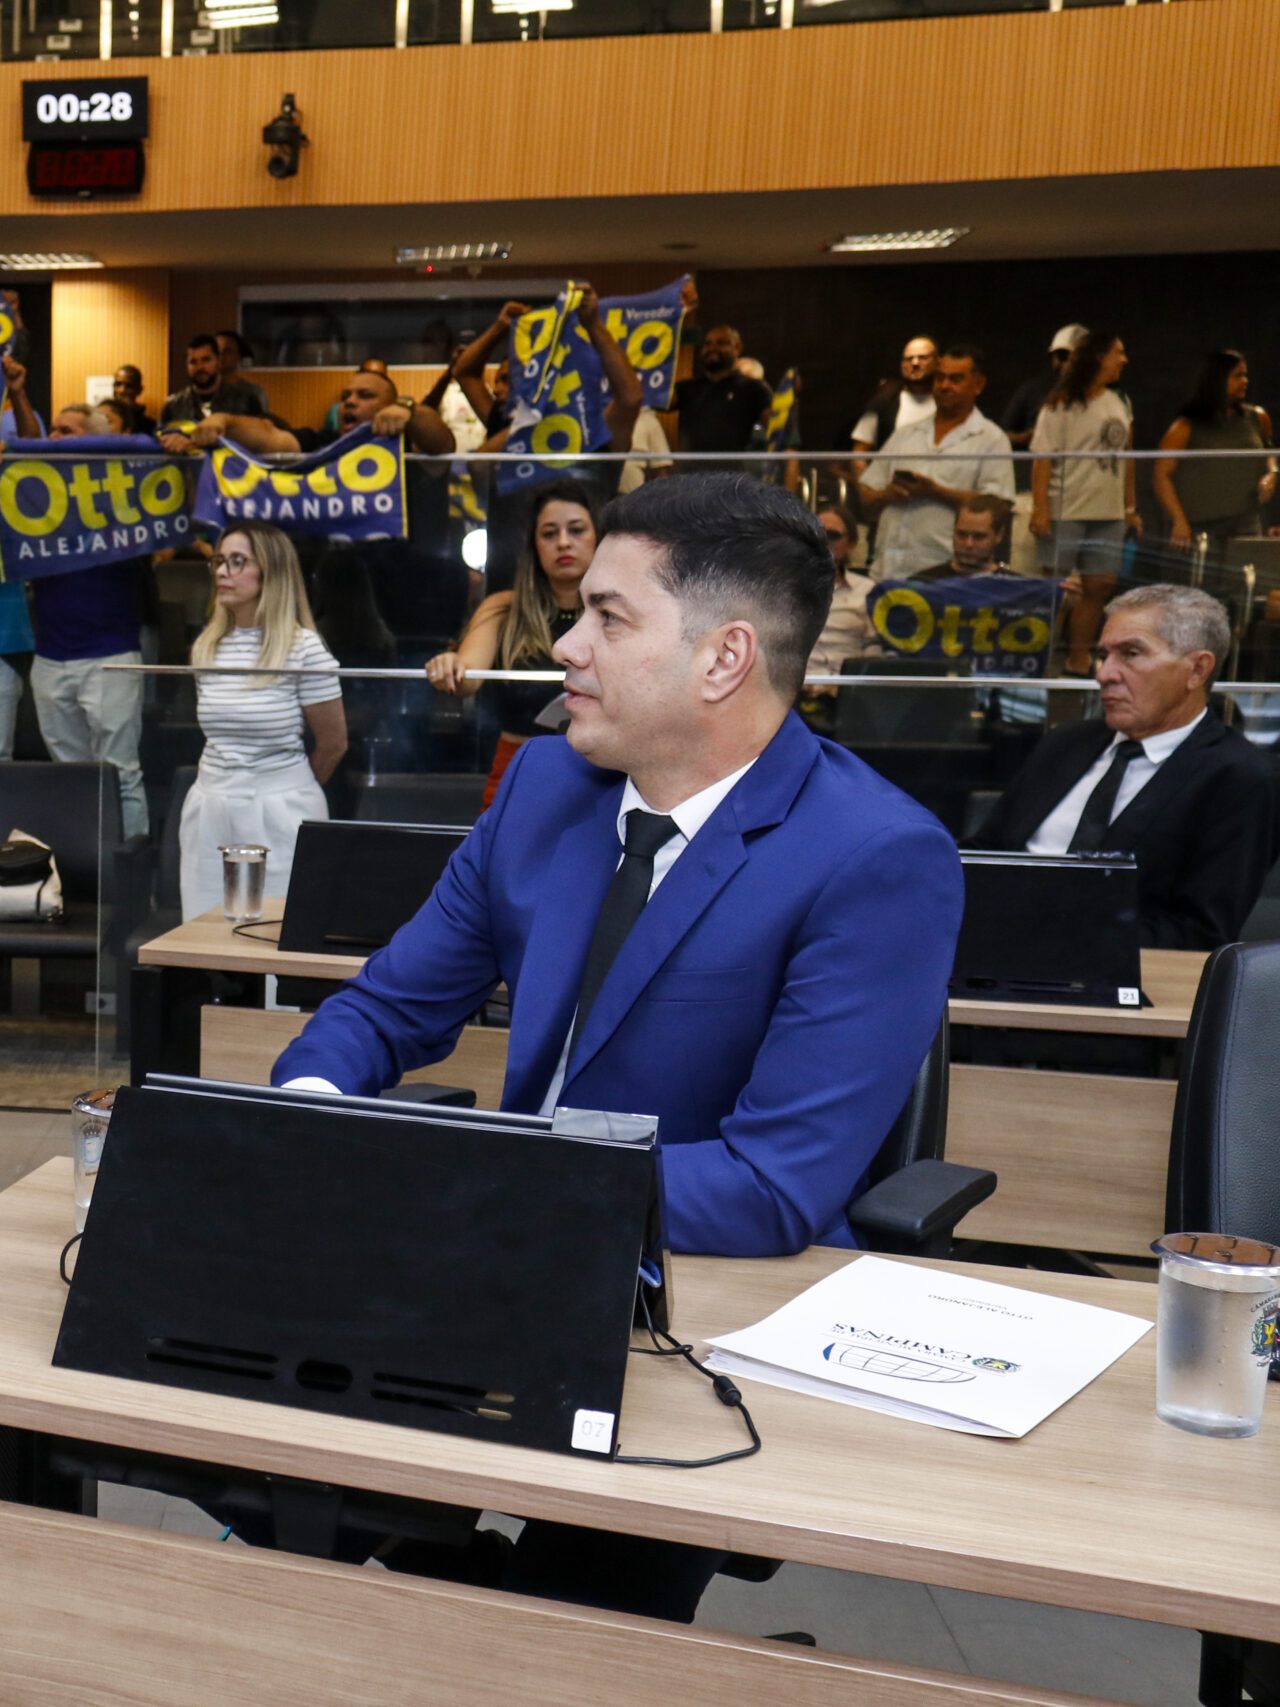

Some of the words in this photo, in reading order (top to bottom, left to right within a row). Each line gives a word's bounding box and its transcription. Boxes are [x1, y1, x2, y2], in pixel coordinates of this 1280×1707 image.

[36, 91, 133, 123] 00:28
[18, 515, 189, 560] ALEJANDRO
[873, 588, 1050, 657] Otto
[833, 1322, 972, 1359] CAMPINAS
[582, 1420, 605, 1438] 07
